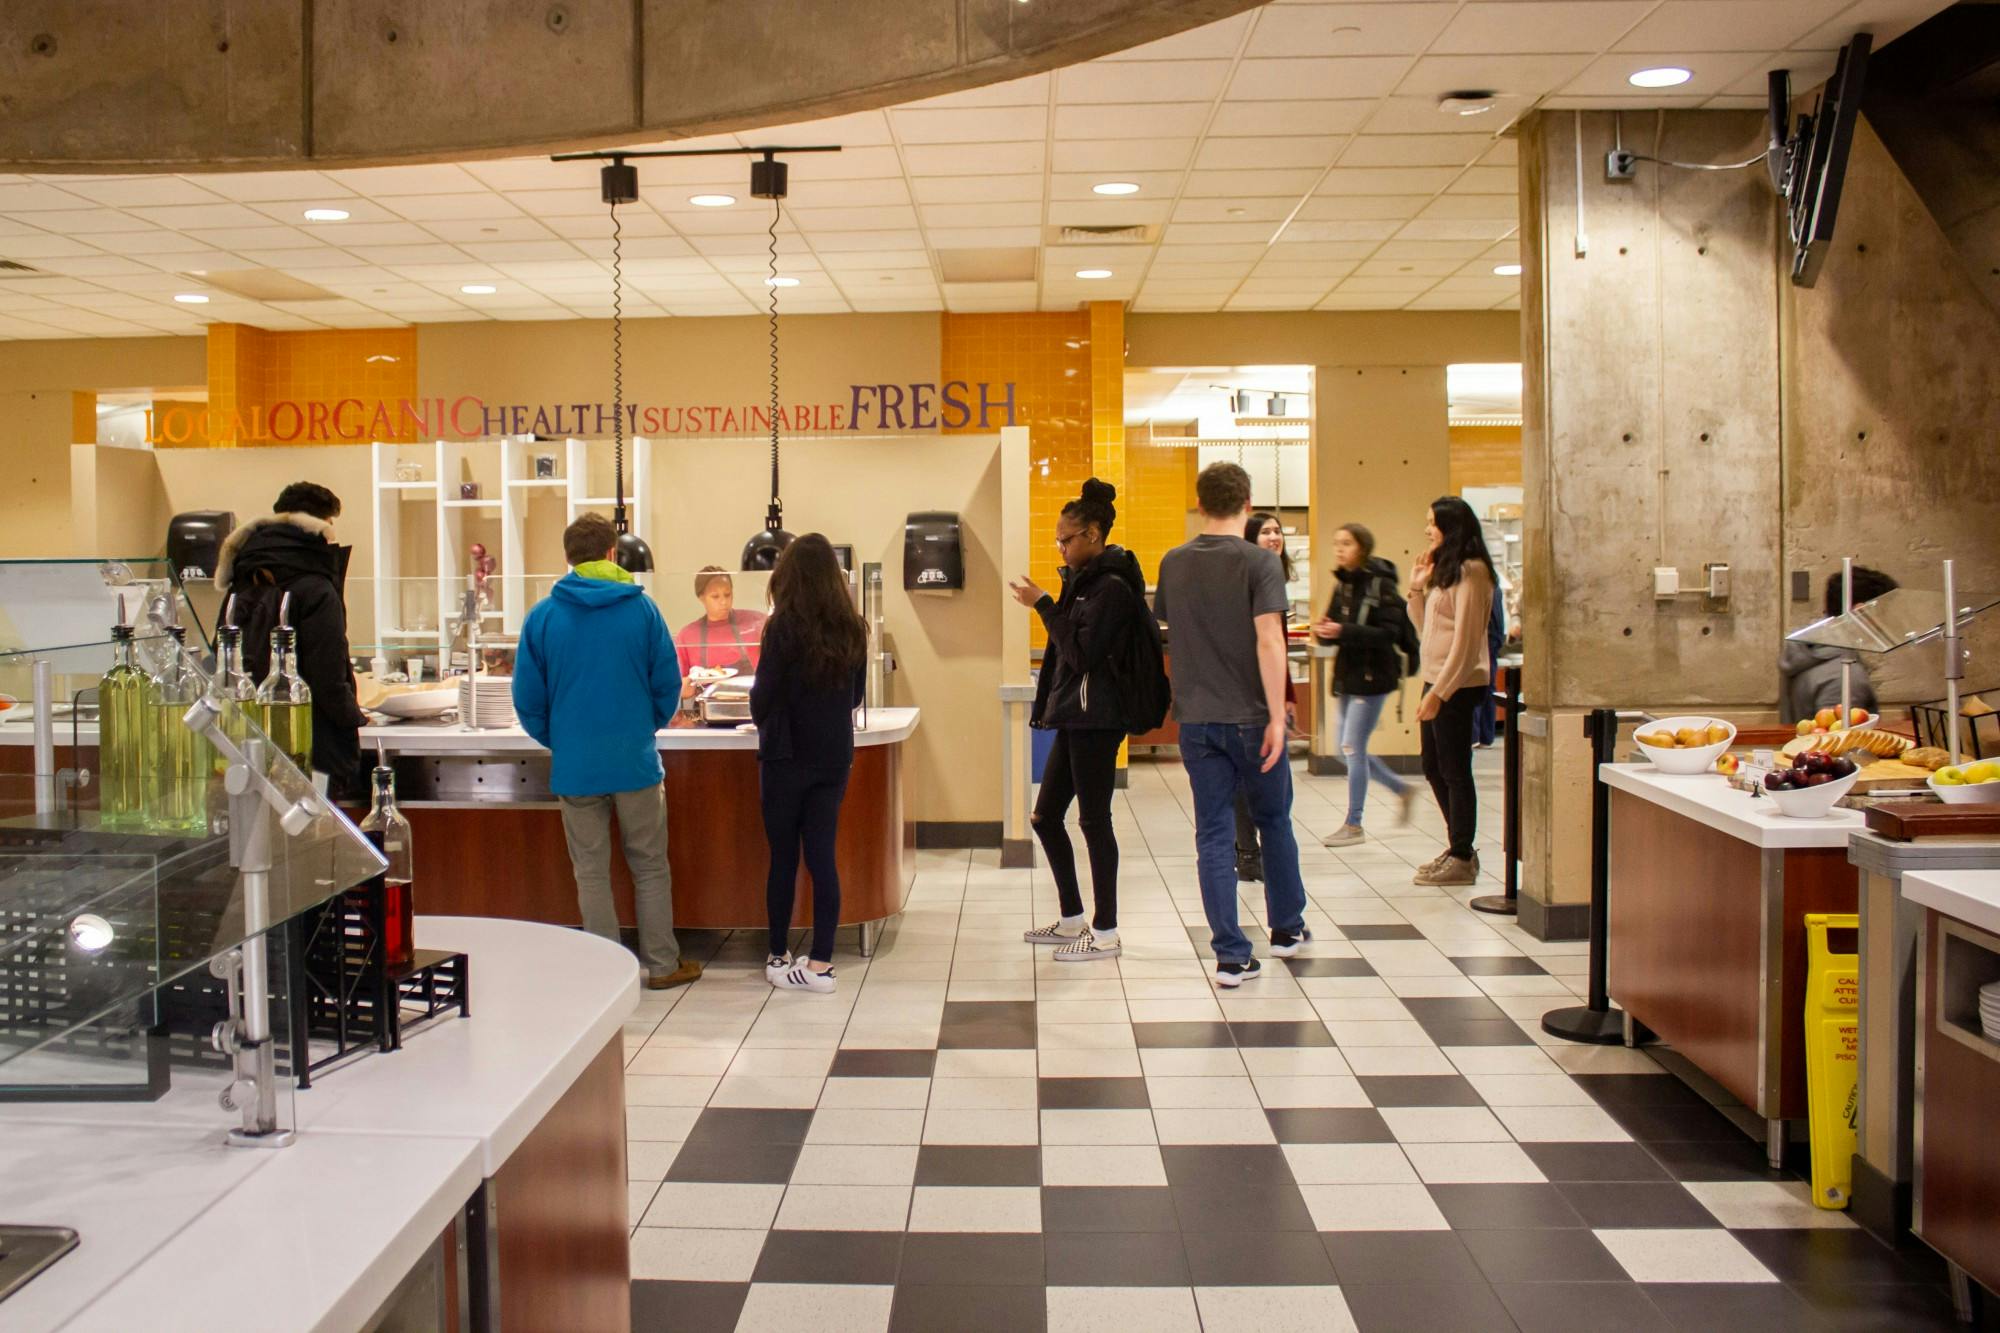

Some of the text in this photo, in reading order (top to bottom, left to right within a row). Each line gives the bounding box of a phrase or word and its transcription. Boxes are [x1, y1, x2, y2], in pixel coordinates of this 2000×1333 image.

[144, 381, 1016, 444] LOCAL ORGANIC HEALTHY SUSTAINABLE FRESH
